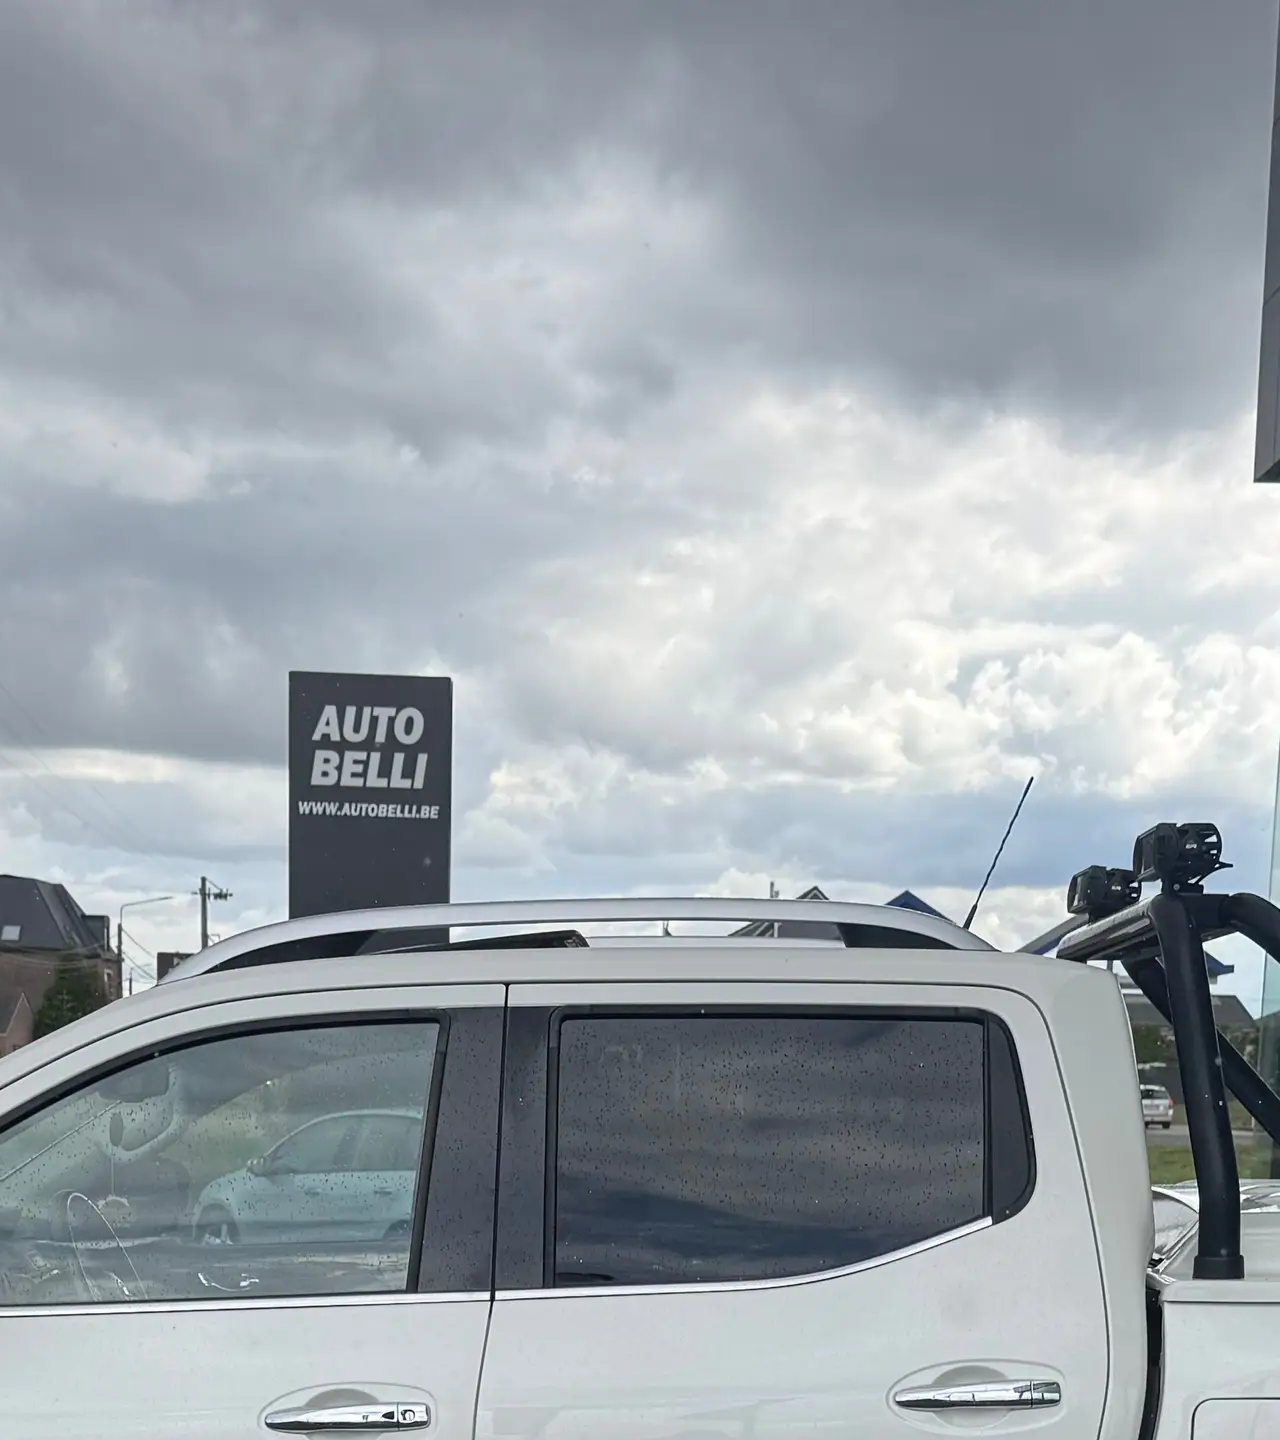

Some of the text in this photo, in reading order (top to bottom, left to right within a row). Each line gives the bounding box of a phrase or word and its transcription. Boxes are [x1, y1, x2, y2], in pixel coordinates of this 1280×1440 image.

[311, 705, 425, 745] AUTO
[310, 749, 428, 790] BELLI
[298, 801, 440, 819] WWW.AUTOBELLI.BE
